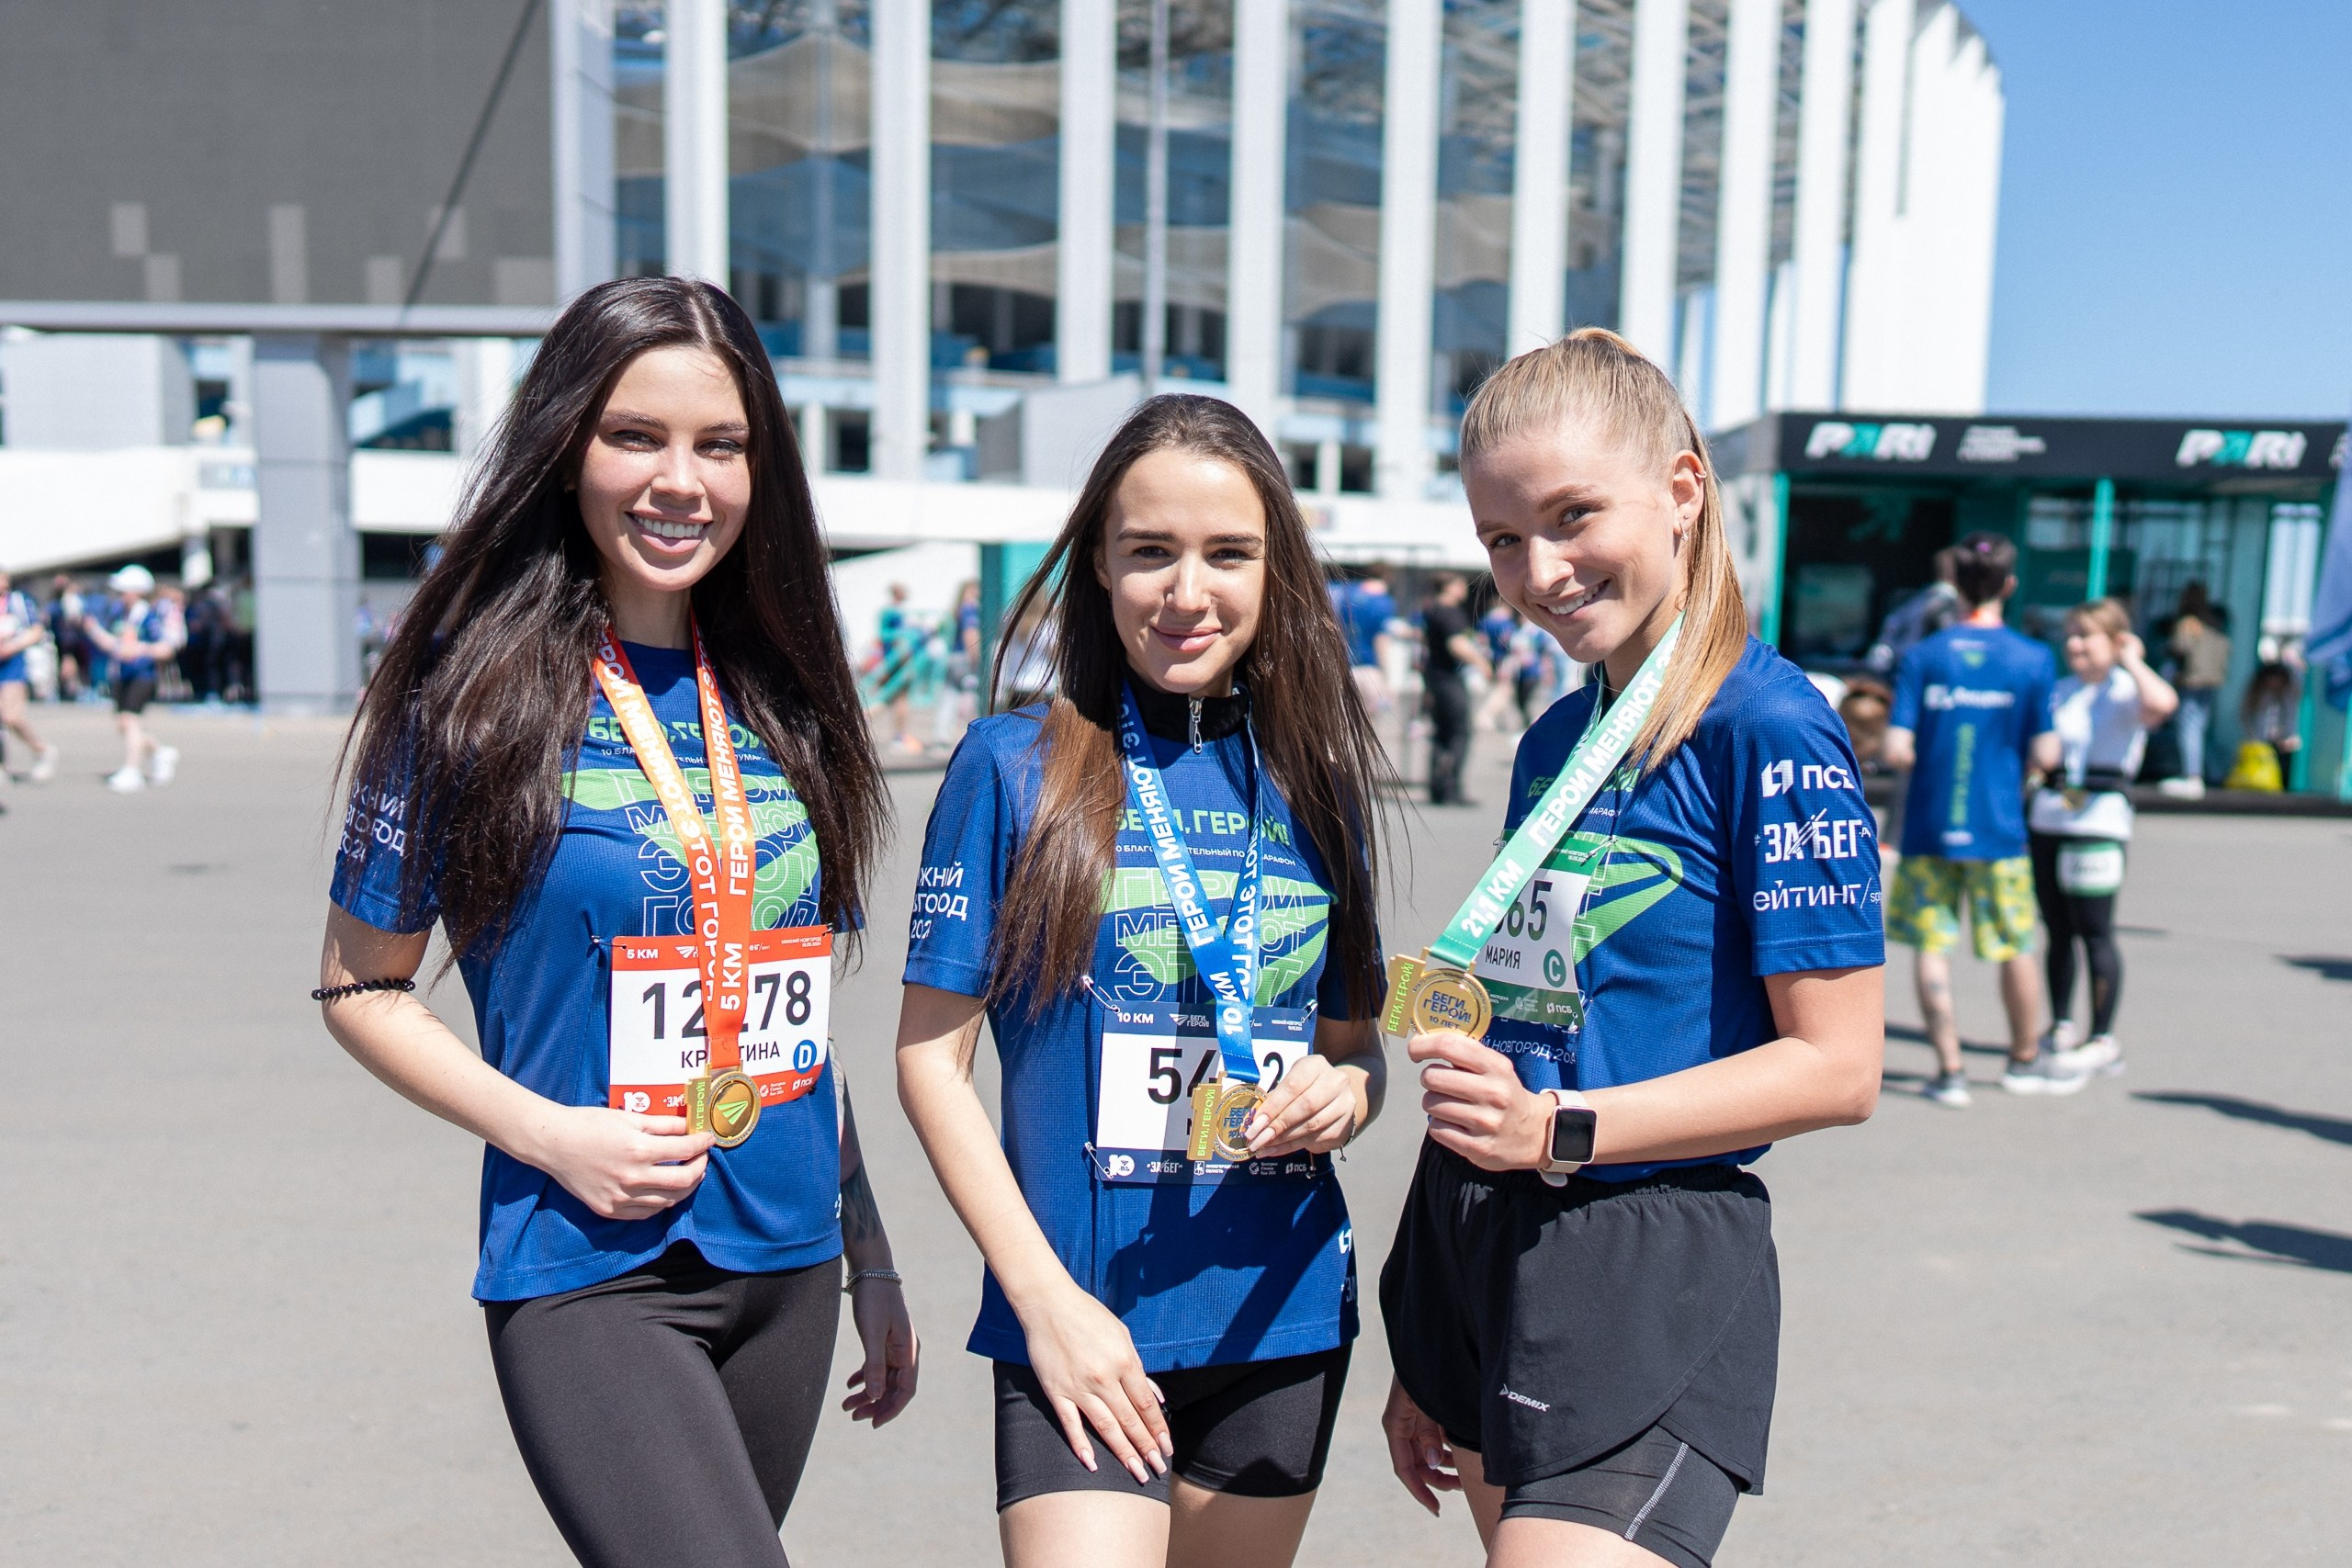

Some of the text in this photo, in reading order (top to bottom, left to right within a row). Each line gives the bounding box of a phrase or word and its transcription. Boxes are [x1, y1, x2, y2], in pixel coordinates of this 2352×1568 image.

[706, 690, 741, 802] МЕНЯЮТ
[1527, 671, 1663, 847] ГЕРОИ МЕНЯЮТ
[681, 818, 718, 896] ЭТОТ
[726, 806, 750, 897] ГЕРОИ
[1166, 863, 1216, 948] ГЕРОИ
[1232, 885, 1257, 952] ЭТОТ
[1493, 880, 1553, 941] 65
[627, 950, 635, 959] 5
[1485, 944, 1521, 970] МАРИЯ
[1395, 962, 1415, 1004] ГЕРОЙ!
[643, 971, 811, 1040] 1278
[720, 994, 741, 1011] 5
[1117, 1011, 1131, 1023] 10
[1423, 998, 1472, 1024] ГЕРОЙ!
[1555, 1003, 1573, 1014] ПСБ
[1222, 1007, 1243, 1035] 10
[1429, 1015, 1461, 1030] 10 ЛЕТ
[681, 1041, 781, 1068] КРТИНА
[1147, 1046, 1284, 1105] 542
[1507, 1391, 1550, 1412] DEMIX
